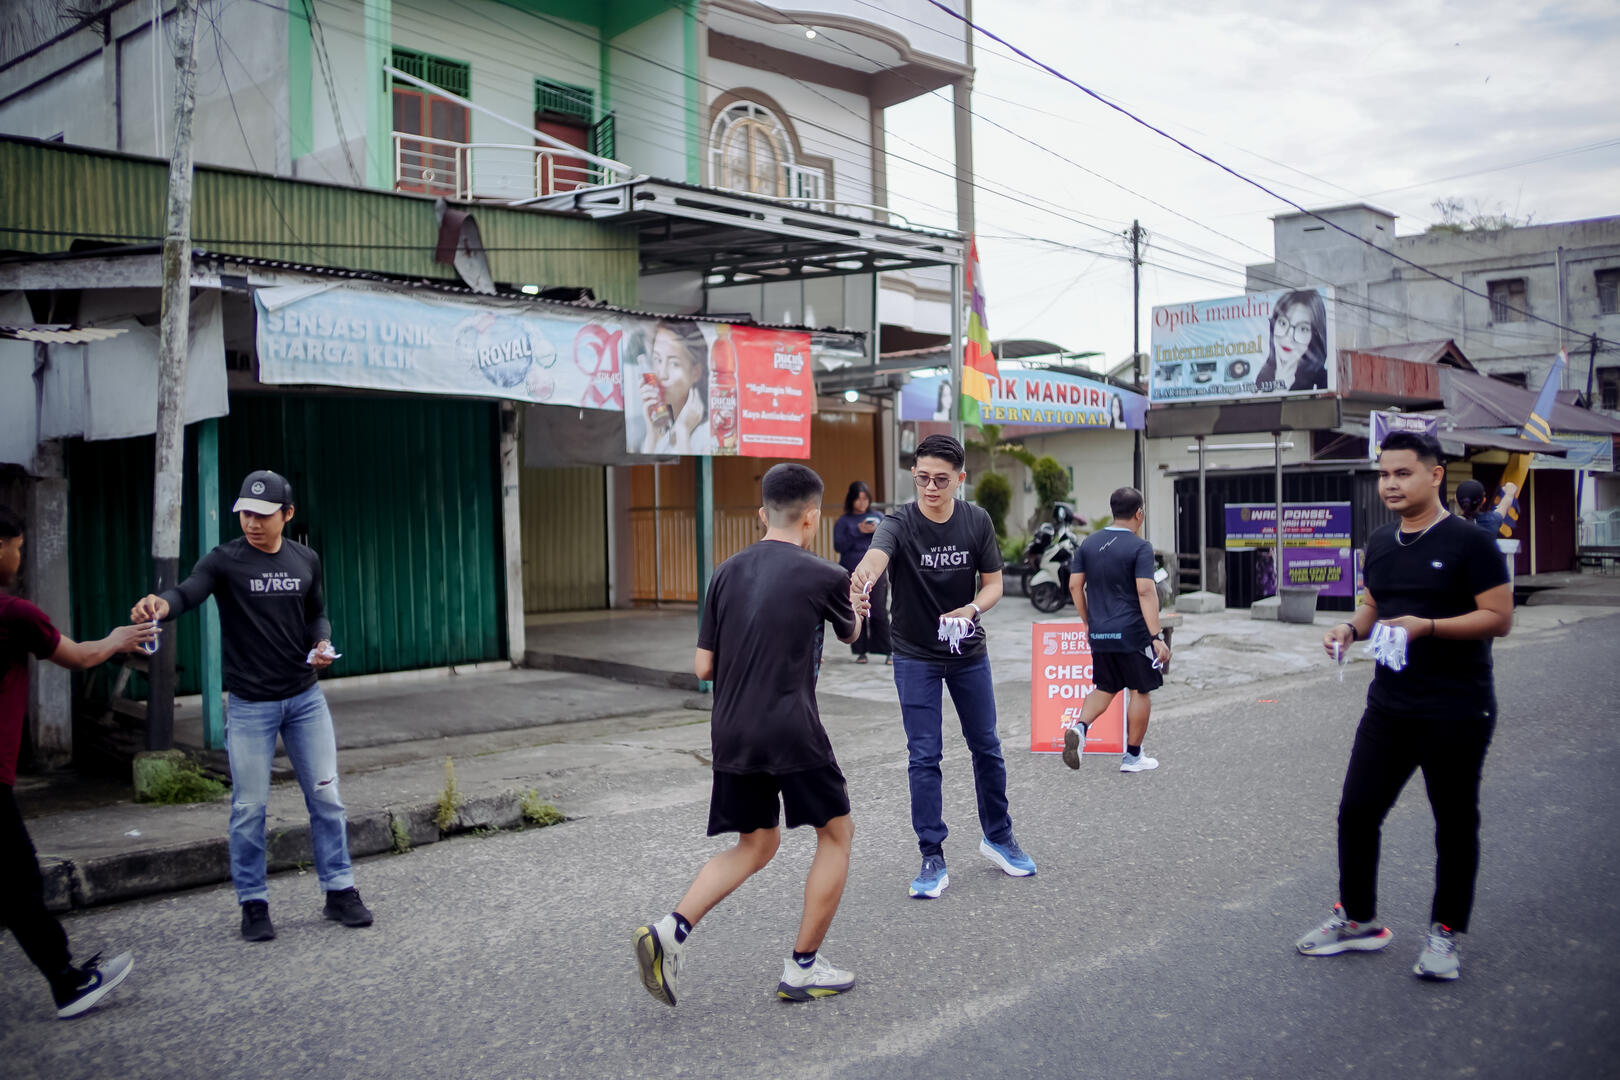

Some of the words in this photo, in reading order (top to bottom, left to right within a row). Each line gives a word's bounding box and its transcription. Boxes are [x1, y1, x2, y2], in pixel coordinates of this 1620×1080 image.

[266, 310, 374, 340] SENSASI
[1155, 303, 1200, 332] Optik
[1206, 295, 1271, 322] mandiri
[265, 337, 354, 363] HARGA
[478, 334, 533, 369] ROYAL
[1154, 335, 1263, 363] International
[1025, 380, 1108, 408] MANDIRI
[982, 404, 1108, 426] TERNATIONAL
[920, 551, 970, 569] IB/RGT
[942, 544, 957, 552] ARE
[250, 578, 302, 592] IB/RGT
[1048, 684, 1097, 699] POIN
